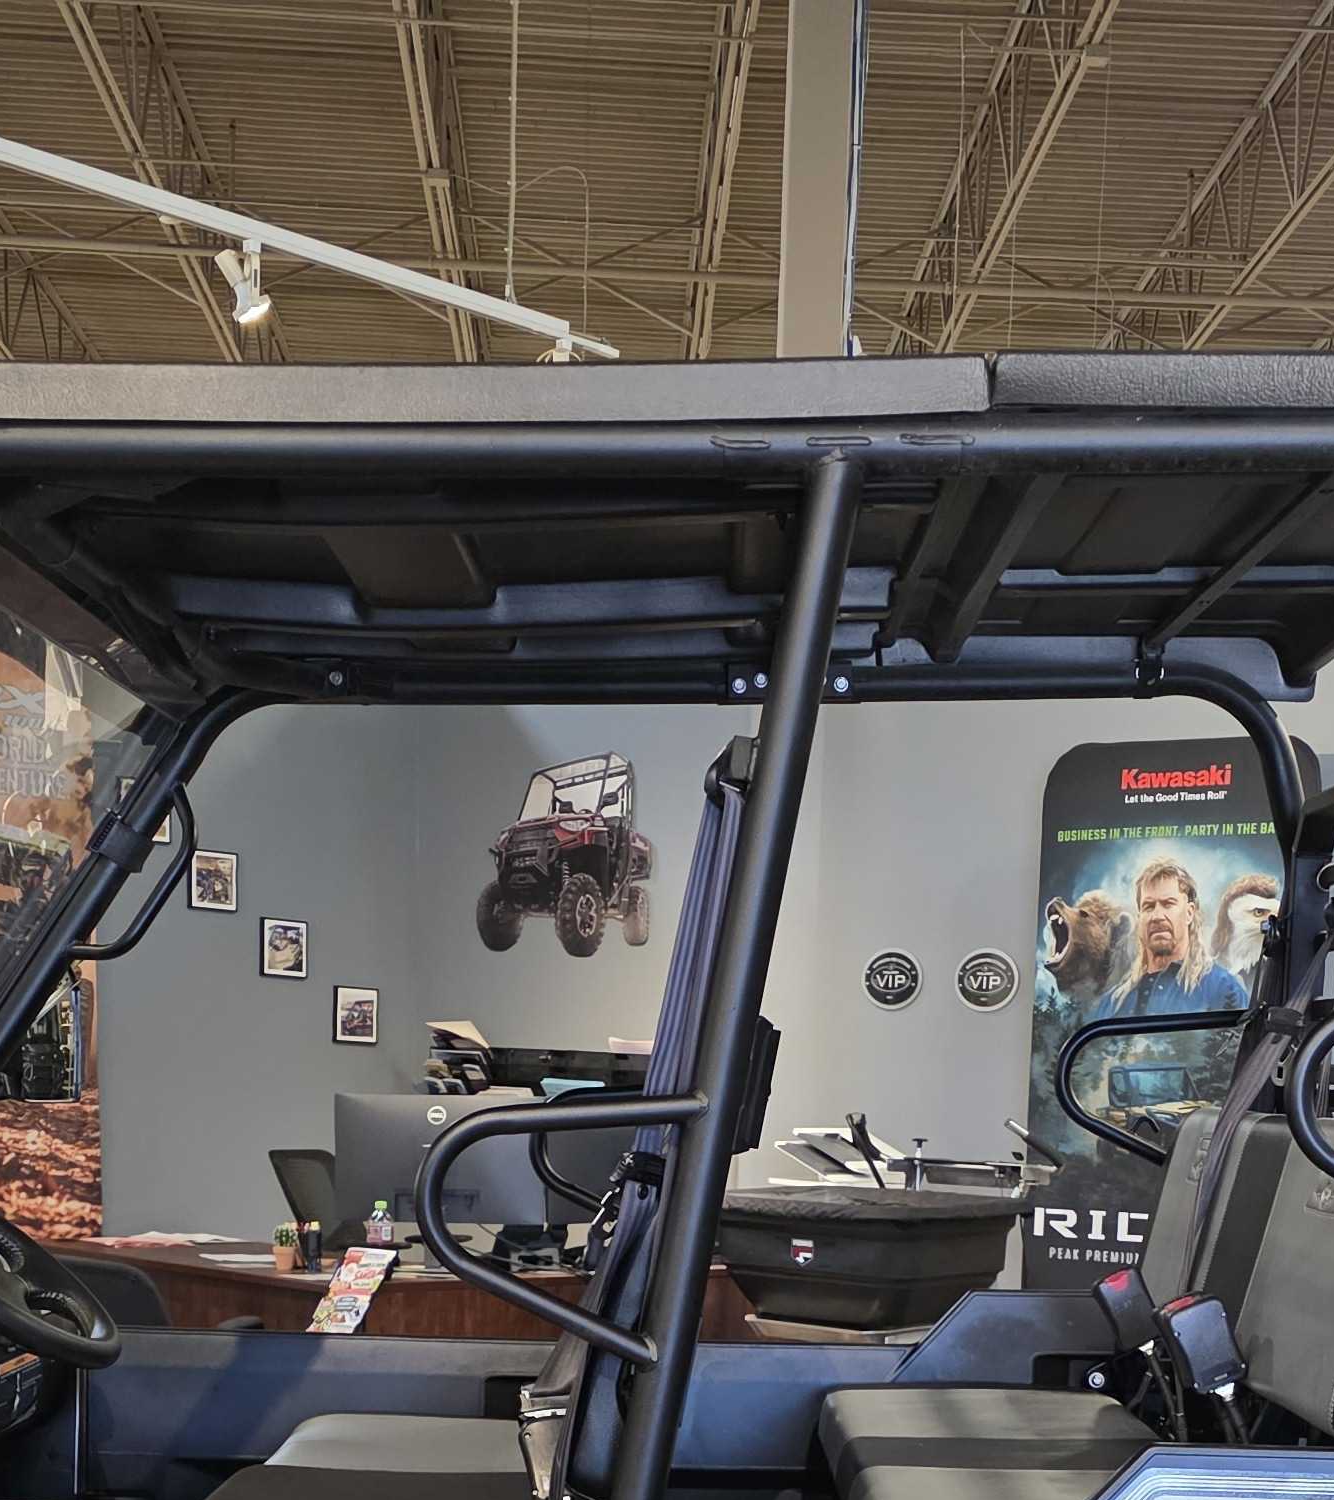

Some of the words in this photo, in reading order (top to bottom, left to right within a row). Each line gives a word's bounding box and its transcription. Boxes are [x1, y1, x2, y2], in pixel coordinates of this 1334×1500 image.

[1121, 763, 1232, 790] Kawasaki
[1125, 794, 1139, 804] Let
[1140, 793, 1154, 803] the
[1155, 791, 1179, 803] Good
[1180, 790, 1206, 802] Times
[1057, 828, 1107, 842] BUSINESS
[1109, 827, 1120, 840] IN
[1123, 826, 1143, 839] THE
[1145, 824, 1182, 838] FRONT.
[1185, 823, 1219, 837] PARTY
[1222, 823, 1234, 835] IN
[1236, 822, 1257, 835] THE
[1260, 821, 1275, 835] BA
[875, 974, 906, 989] VIP
[969, 975, 1002, 990] VIP
[1048, 1246, 1079, 1261] PEAK
